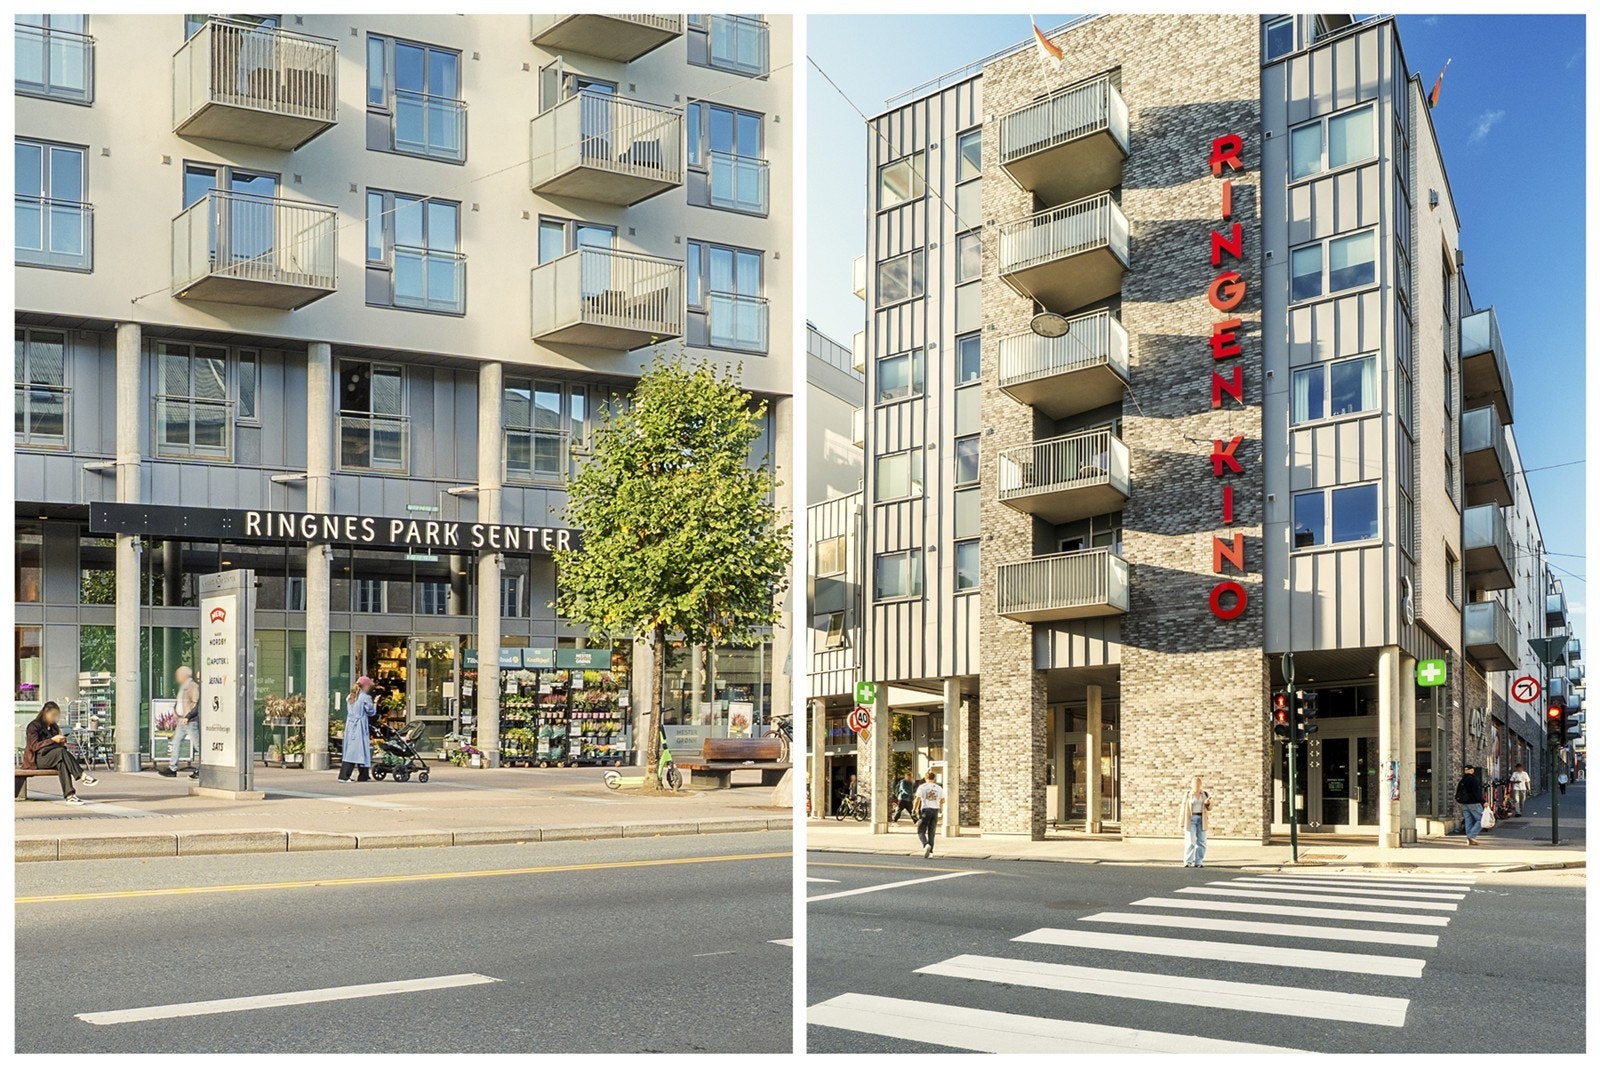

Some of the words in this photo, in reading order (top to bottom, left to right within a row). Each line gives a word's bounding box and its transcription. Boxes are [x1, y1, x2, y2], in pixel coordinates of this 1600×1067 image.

[1208, 133, 1246, 408] RINGEN
[246, 511, 376, 542] RINGNES
[390, 519, 459, 547] PARK
[471, 524, 571, 550] SENTER
[1209, 435, 1247, 620] KINO
[858, 712, 867, 723] 40
[212, 742, 224, 752] SATS
